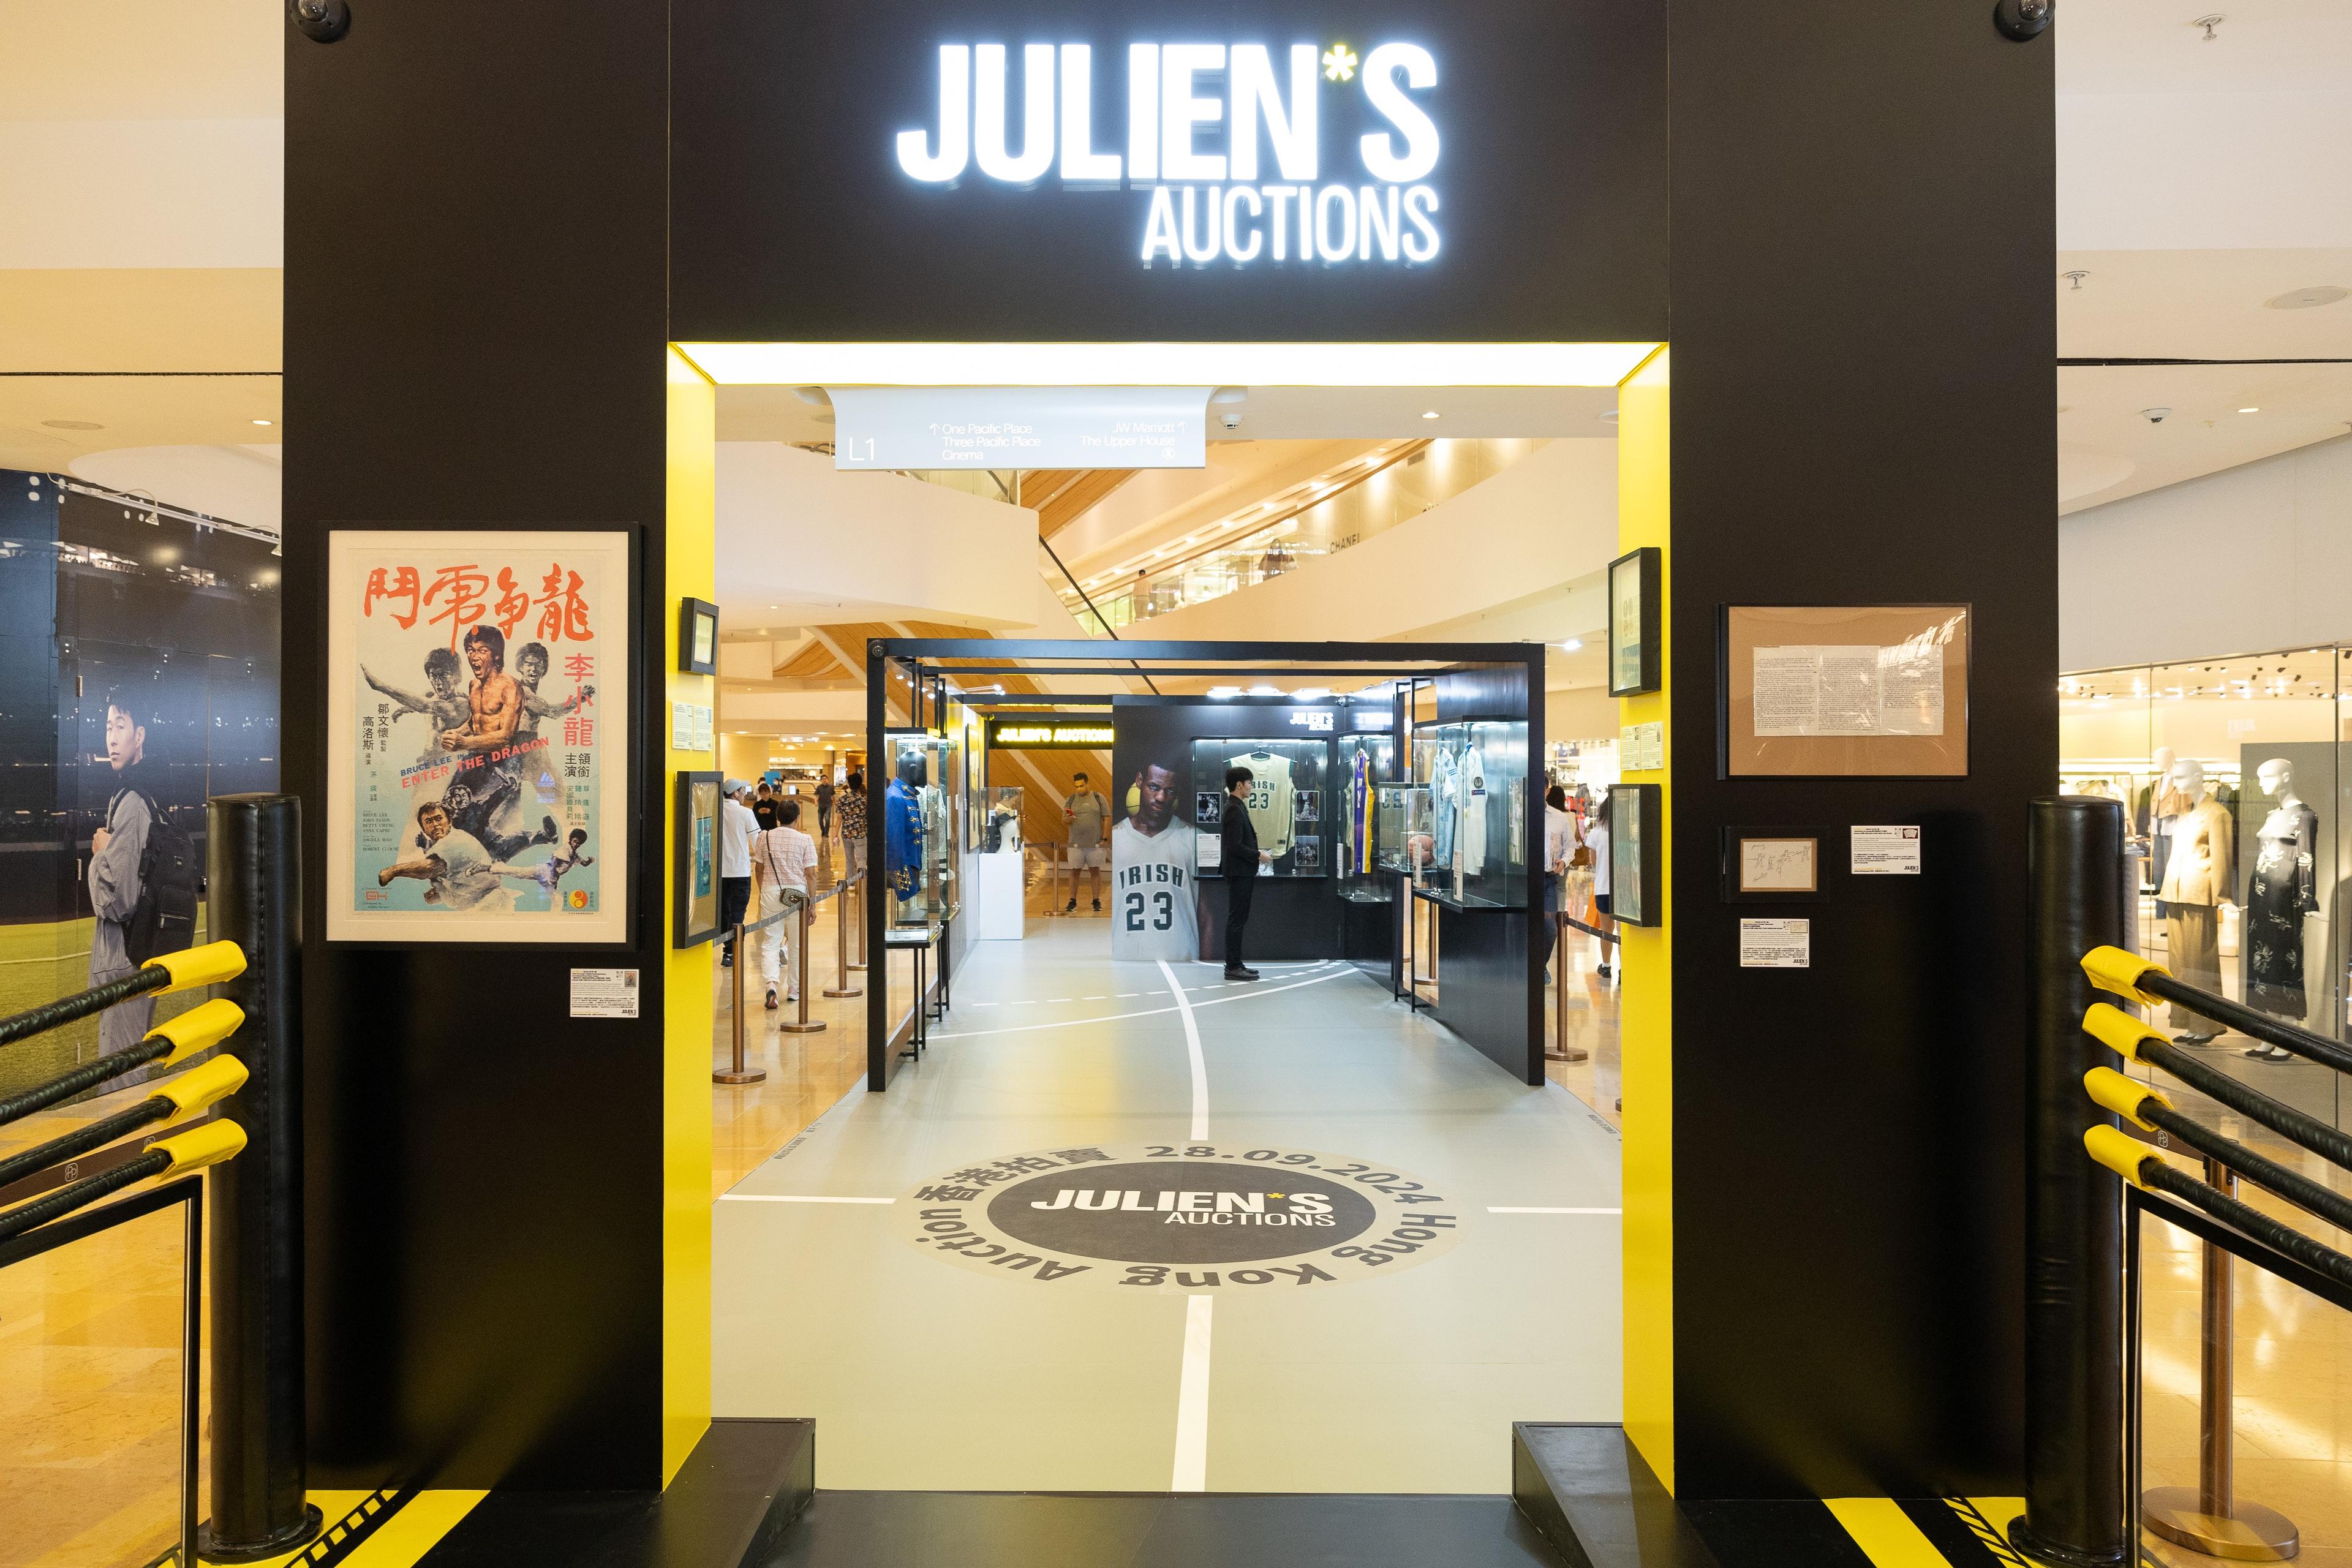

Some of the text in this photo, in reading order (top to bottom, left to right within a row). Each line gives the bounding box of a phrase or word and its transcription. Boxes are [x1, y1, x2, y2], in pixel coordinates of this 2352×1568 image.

[1142, 186, 1439, 262] AUCTIONS
[943, 423, 1033, 434] One Pacific Place
[1112, 422, 1130, 433] JW
[849, 437, 875, 461] L1
[943, 436, 1041, 447] Three Pacific Place
[1080, 435, 1175, 448] The Upper House
[942, 450, 984, 460] Cinema
[564, 653, 594, 747] 李小龍
[363, 716, 374, 750] 高洛斯
[400, 761, 431, 777] BRUCE
[434, 755, 452, 767] LEE
[402, 736, 549, 789] ENTER THE DRAGON
[1252, 781, 1275, 791] RISH
[1249, 793, 1269, 809] 23
[1120, 864, 1184, 890] IRISH
[1126, 892, 1172, 931] 23
[913, 1148, 1119, 1202] 香港拍賣
[1144, 1146, 1444, 1204] 28.09.2024
[1164, 1212, 1336, 1226] AUCTIONS
[916, 1208, 1457, 1287] Hong Kong Auction
